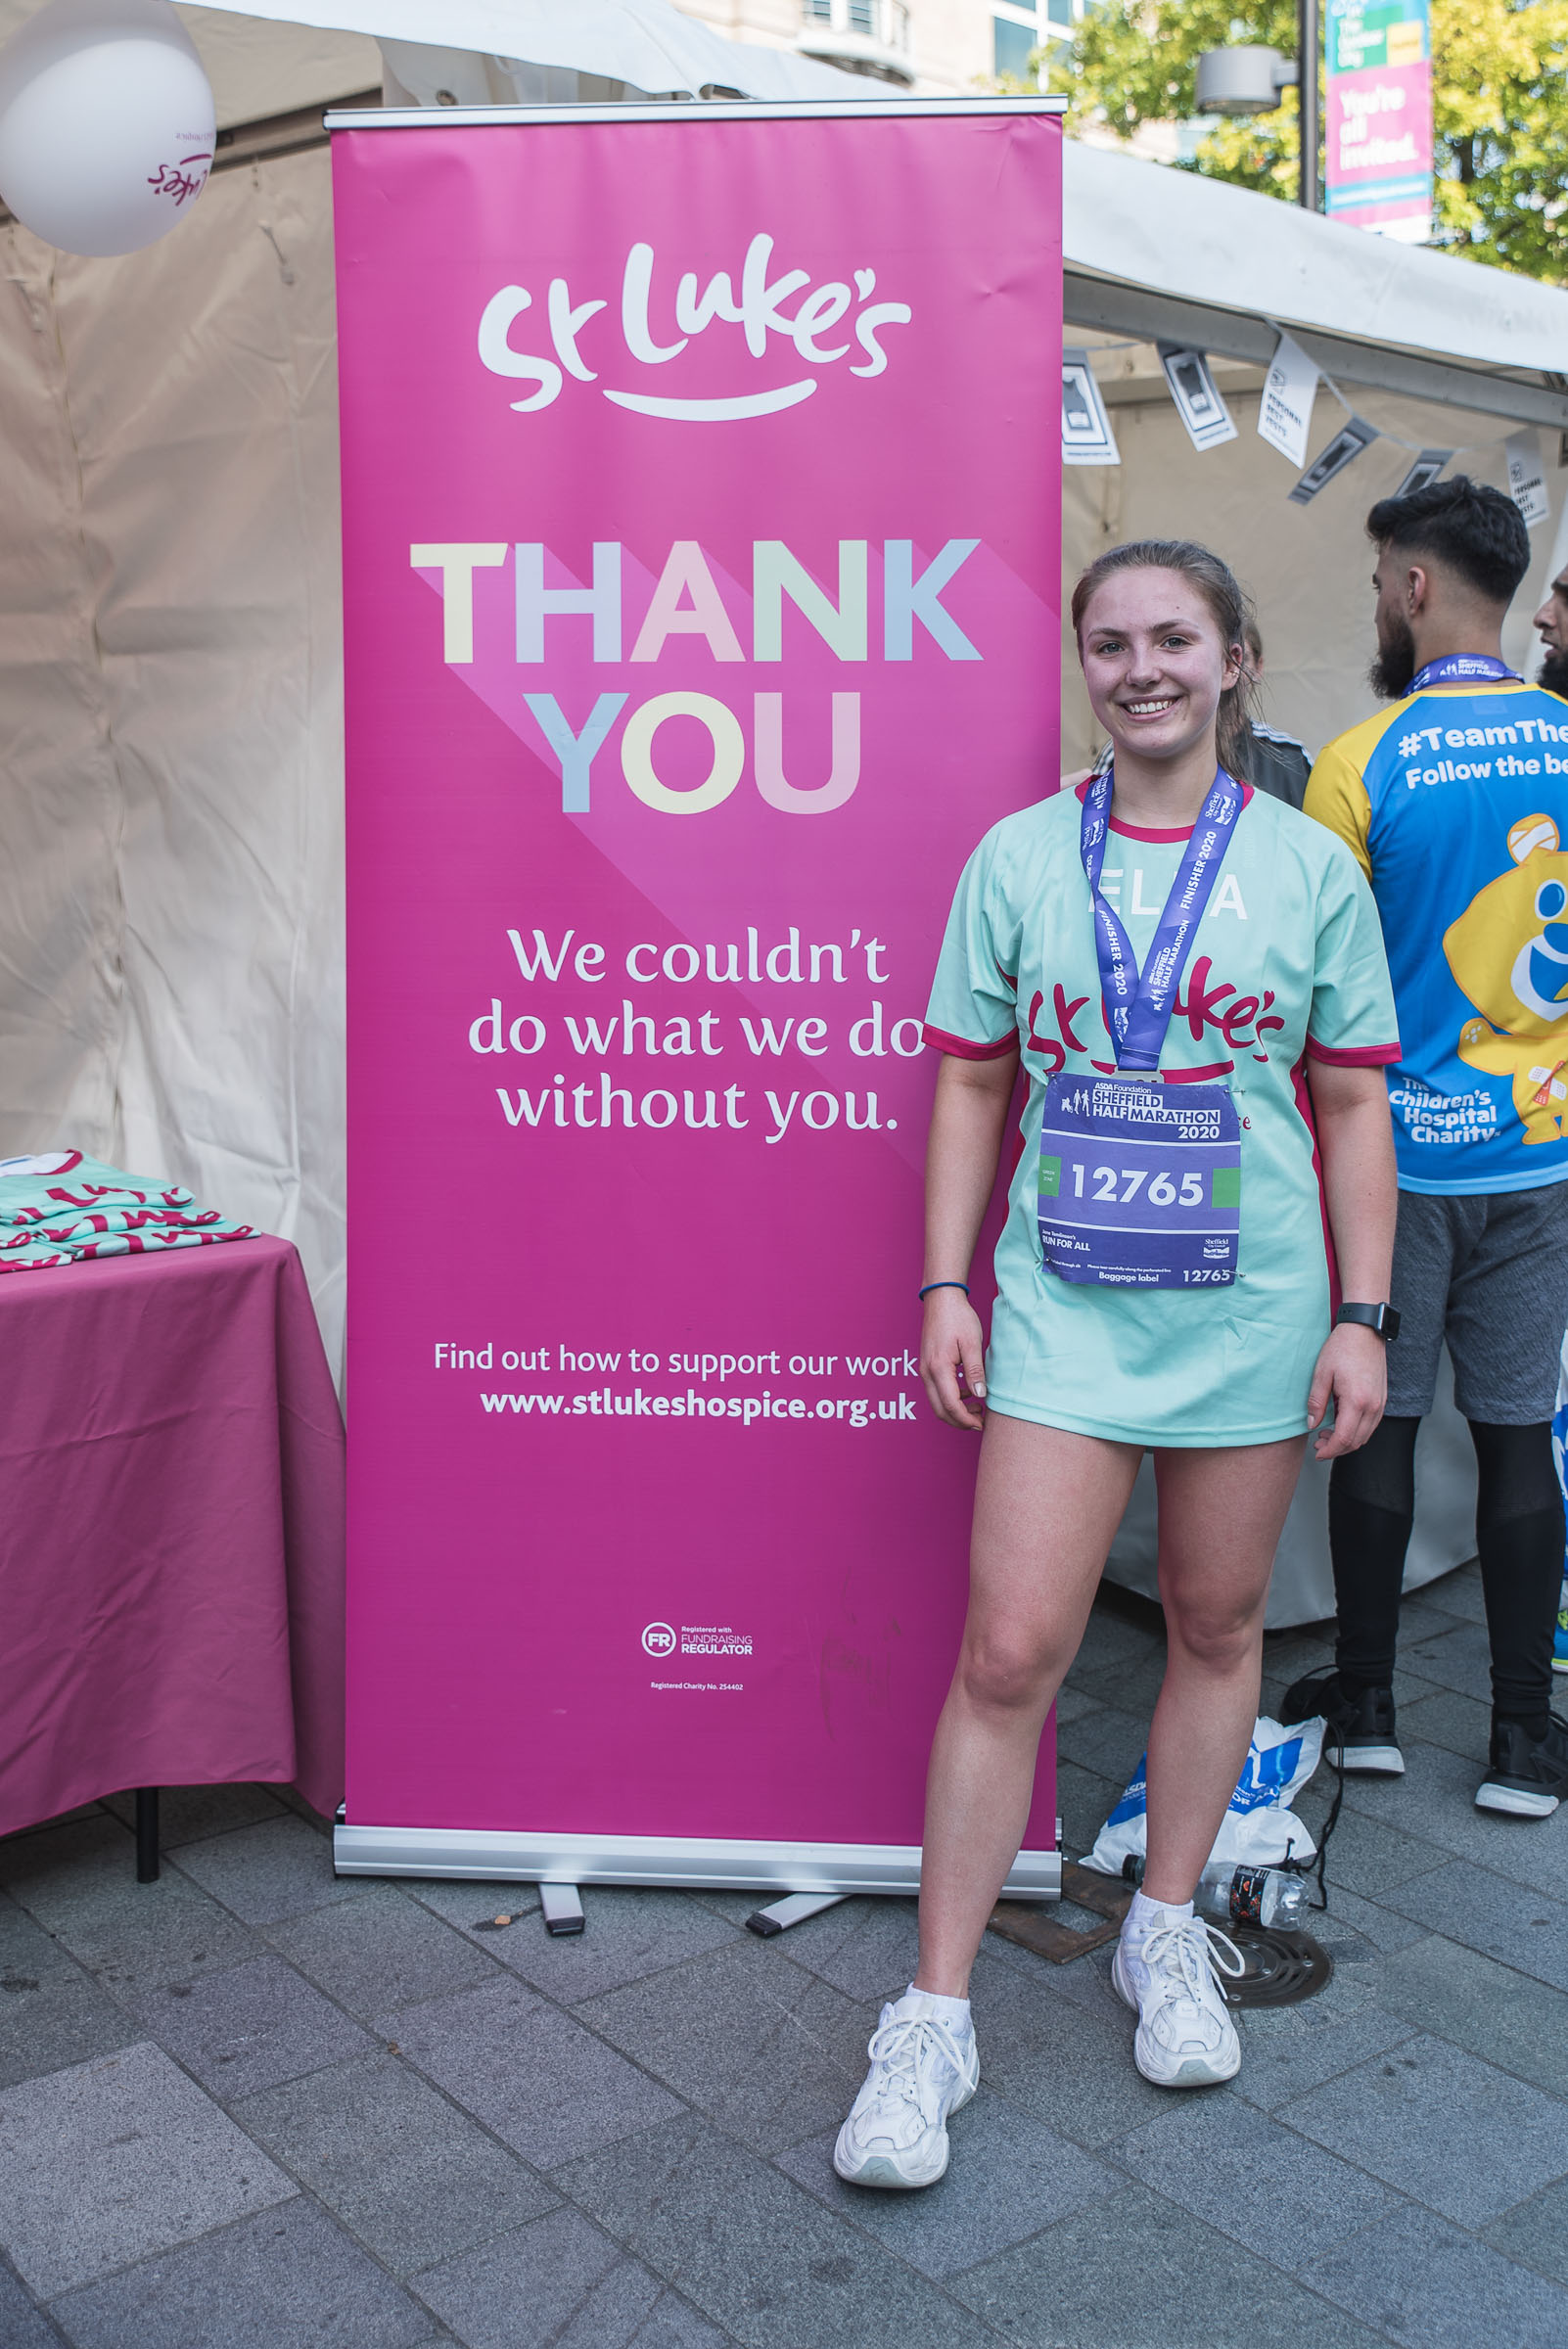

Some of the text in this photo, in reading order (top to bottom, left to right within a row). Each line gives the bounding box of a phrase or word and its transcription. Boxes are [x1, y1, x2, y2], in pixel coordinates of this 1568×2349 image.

[478, 233, 912, 412] St Luke's
[410, 538, 985, 664] THANK
[522, 691, 861, 815] YOU
[1406, 760, 1492, 790] Follow
[1496, 755, 1541, 777] the
[1179, 831, 1218, 910] FINISHER 2020
[1088, 868, 1248, 920] ELA
[506, 927, 891, 984] We couldn't
[1098, 909, 1128, 995] FINISHER 2020
[1161, 919, 1190, 989] HALF MARATHON
[1153, 946, 1172, 987] SHEFFIELD
[468, 998, 926, 1057] do what we do
[1094, 1082, 1152, 1094] ASDA Foundation
[1403, 1077, 1430, 1091] The
[495, 1072, 899, 1144] without you.
[1093, 1090, 1161, 1108] SHEFFIELD
[1388, 1089, 1492, 1110] Children's
[1092, 1103, 1128, 1119] HALF
[1130, 1109, 1220, 1124] MARATHON
[1404, 1105, 1498, 1129] Hospital
[1177, 1126, 1221, 1139] 2020
[1410, 1126, 1496, 1143] Charity
[1072, 1164, 1204, 1207] 12765
[1056, 1238, 1073, 1249] FOR
[1074, 1241, 1091, 1252] ALL
[1098, 1271, 1159, 1283] Baggage label
[1182, 1268, 1230, 1282] 12765
[435, 1342, 919, 1381] Find out how to support our work
[481, 1388, 917, 1428] www.stlukeshospice.org.uk
[648, 1633, 670, 1647] FR
[681, 1634, 753, 1644] FUNDRAISING
[681, 1644, 753, 1655] REGULATOR
[651, 1681, 682, 1690] Registered
[683, 1681, 706, 1691] Charity
[1232, 1792, 1250, 1806] OR
